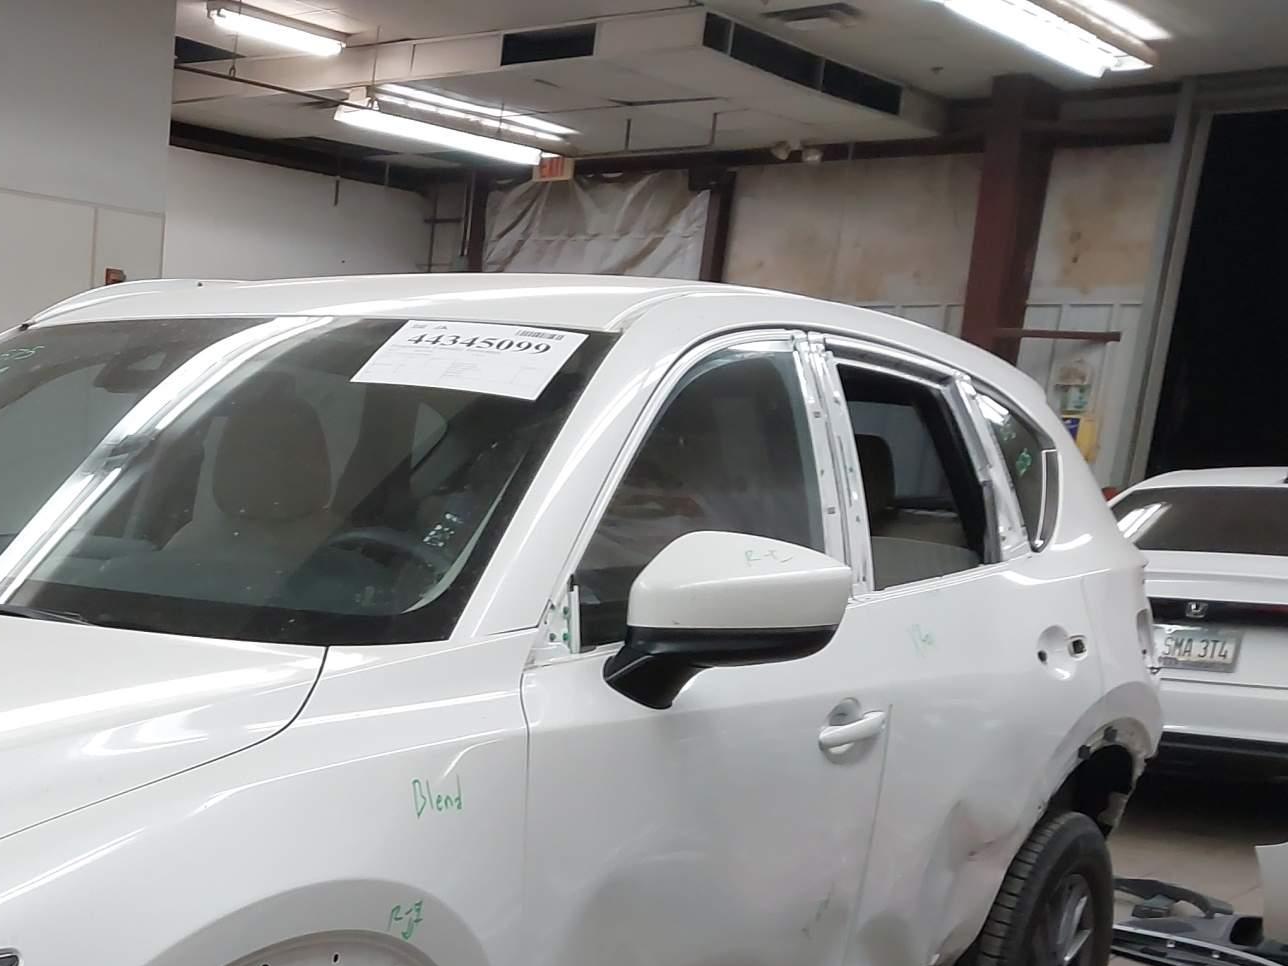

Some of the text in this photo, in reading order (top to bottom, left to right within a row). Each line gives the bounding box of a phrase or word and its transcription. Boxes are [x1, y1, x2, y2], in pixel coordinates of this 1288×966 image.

[407, 333, 552, 355] 44345099
[1198, 639, 1229, 659] 3T4
[412, 775, 462, 818] Blend
